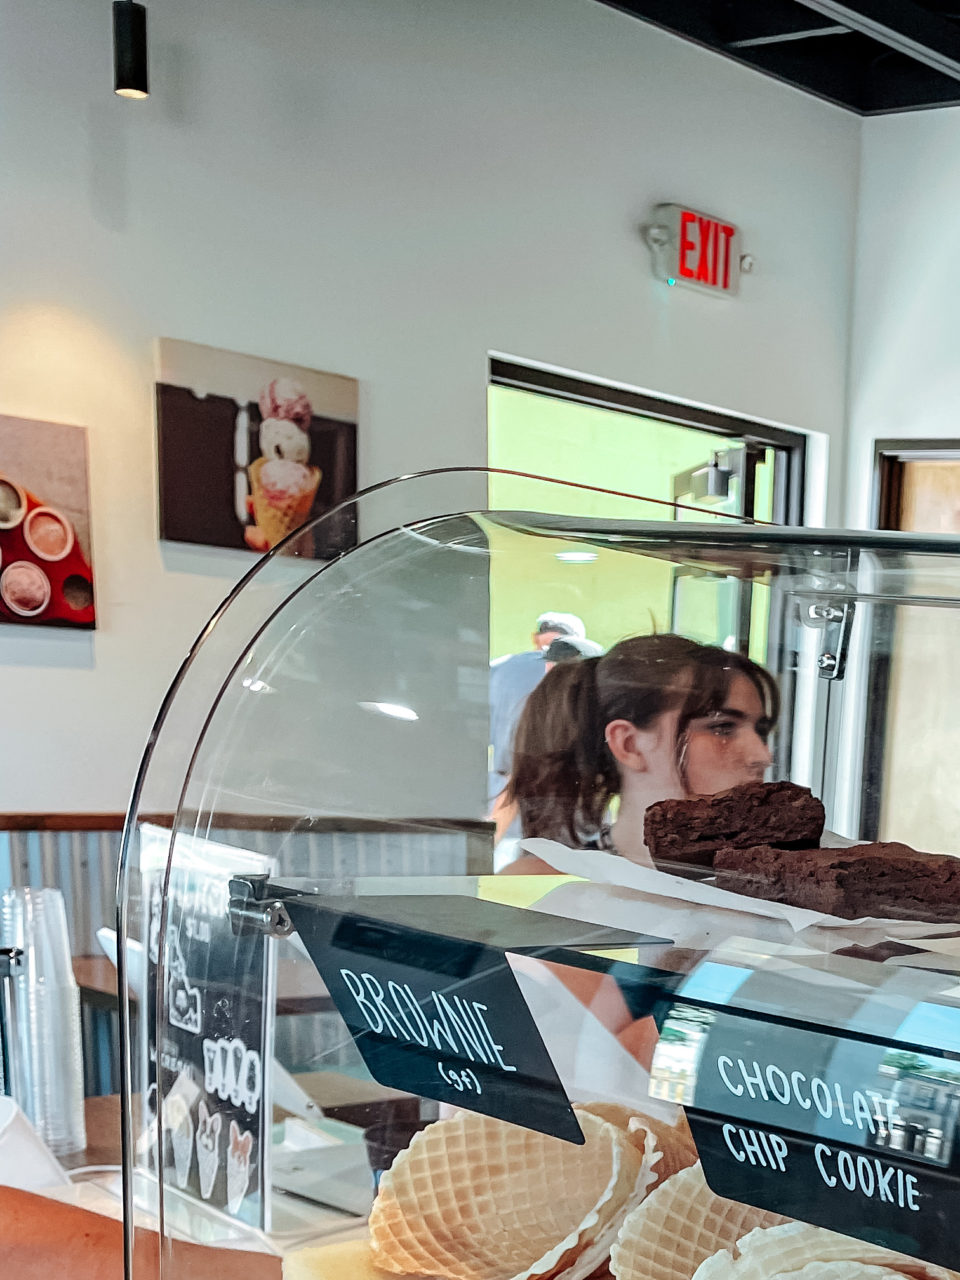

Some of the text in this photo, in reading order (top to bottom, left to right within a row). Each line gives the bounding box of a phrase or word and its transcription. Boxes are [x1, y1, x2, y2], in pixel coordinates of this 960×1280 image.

[678, 211, 735, 290] EXIT
[340, 968, 517, 1072] BROWNIE
[717, 1055, 902, 1138] CHOCOLATE
[722, 1123, 921, 1212] CHIP COOKIE
